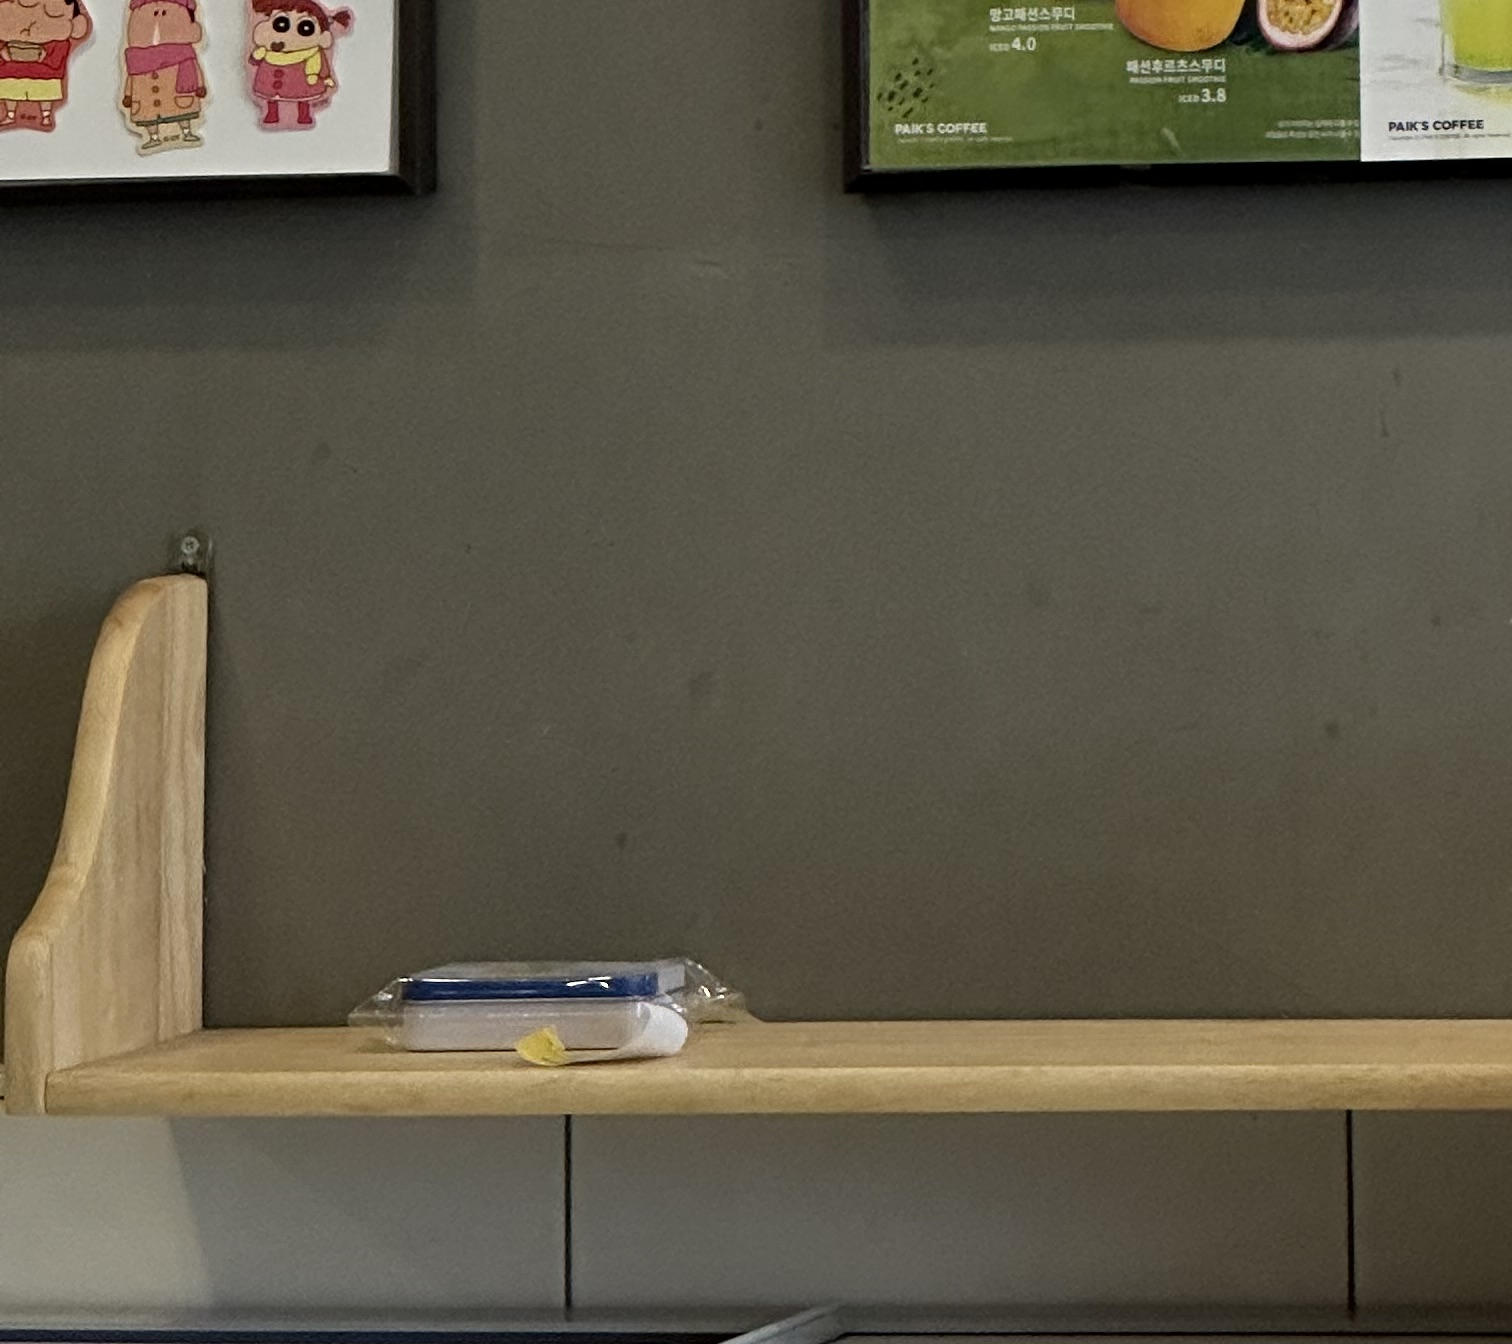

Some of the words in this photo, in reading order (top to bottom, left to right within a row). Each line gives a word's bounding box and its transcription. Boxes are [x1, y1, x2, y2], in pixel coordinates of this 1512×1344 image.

[989, 6, 1077, 23] 망고패션스무디
[1011, 36, 1037, 52] 4.0
[1201, 87, 1227, 104] 3.8
[936, 121, 987, 134] COFFEE
[1431, 118, 1485, 131] COFFEE
